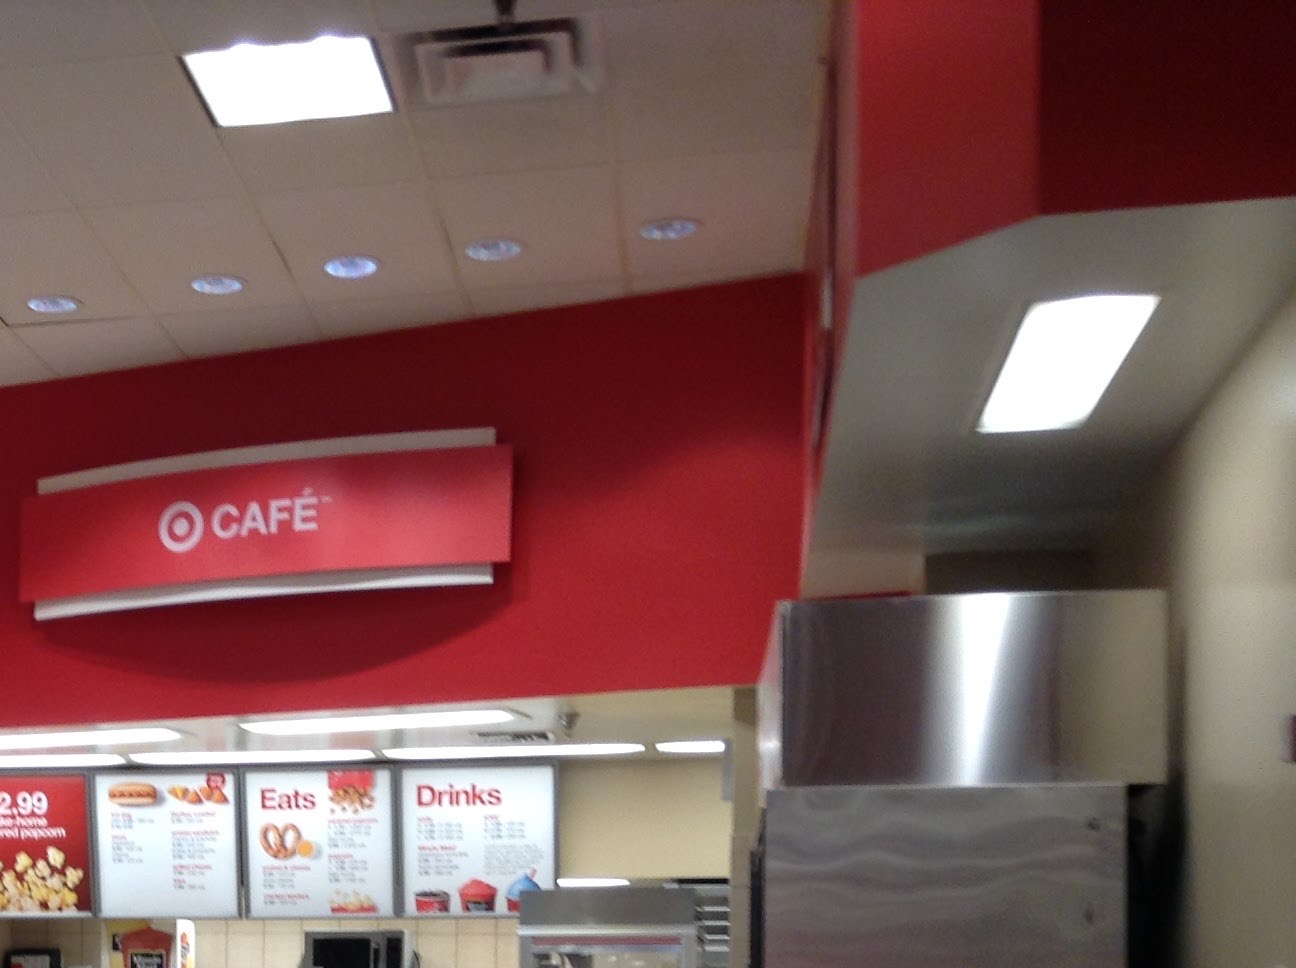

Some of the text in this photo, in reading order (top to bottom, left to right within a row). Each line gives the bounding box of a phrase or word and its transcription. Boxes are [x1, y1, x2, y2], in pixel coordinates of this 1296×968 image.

[212, 487, 319, 539] CAFÉ
[260, 786, 316, 810] Eats
[417, 783, 502, 807] Drinks
[20, 826, 66, 840] popcorn
